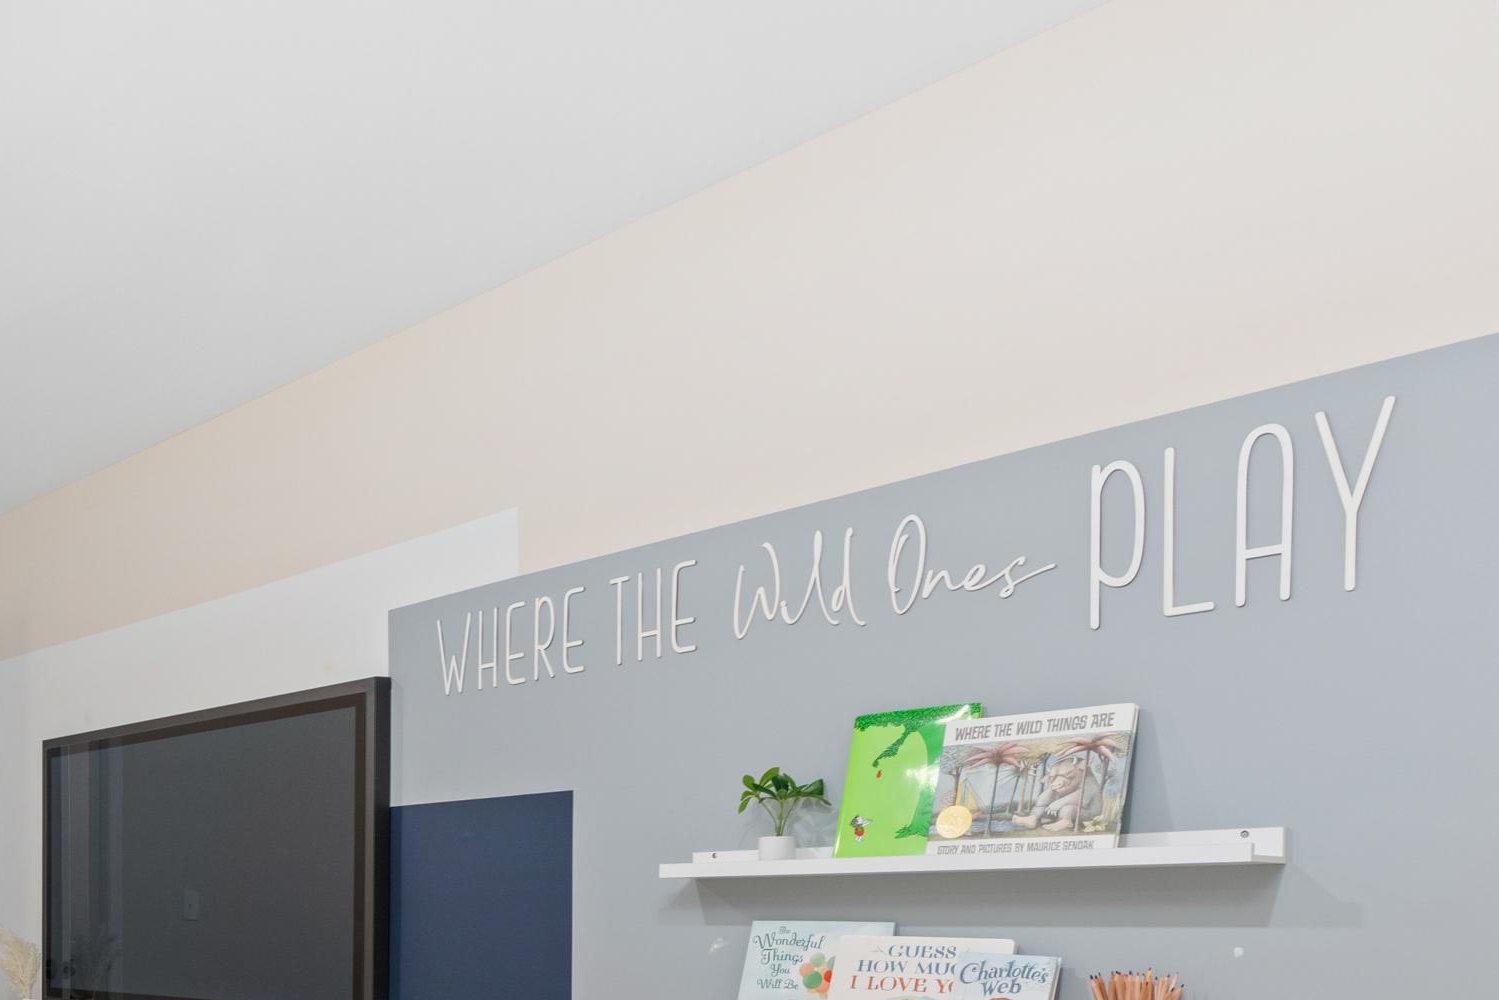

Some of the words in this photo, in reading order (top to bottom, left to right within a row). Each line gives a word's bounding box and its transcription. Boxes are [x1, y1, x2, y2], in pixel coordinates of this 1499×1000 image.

[436, 585, 587, 696] WHERE
[608, 558, 698, 666] THE
[732, 525, 868, 641] Wild
[887, 513, 1057, 616] Ones
[1089, 394, 1397, 631] PLAY
[954, 724, 992, 741] WHERE
[994, 722, 1013, 738] THE
[1016, 719, 1043, 736] WILD
[1047, 714, 1088, 733] THINGS
[1090, 711, 1116, 729] ARE
[960, 844, 976, 854] AND
[978, 842, 1013, 854] PICTURES
[1014, 842, 1026, 853] BY
[753, 931, 826, 951] Wonderful
[760, 948, 803, 965] Things
[888, 944, 957, 959] GUESS
[770, 963, 790, 977] You
[857, 959, 909, 974] HOW
[959, 959, 1049, 984] Charlotte's
[756, 978, 783, 989] Will
[783, 978, 800, 990] Be
[850, 975, 858, 989] I
[867, 976, 927, 993] LOVE
